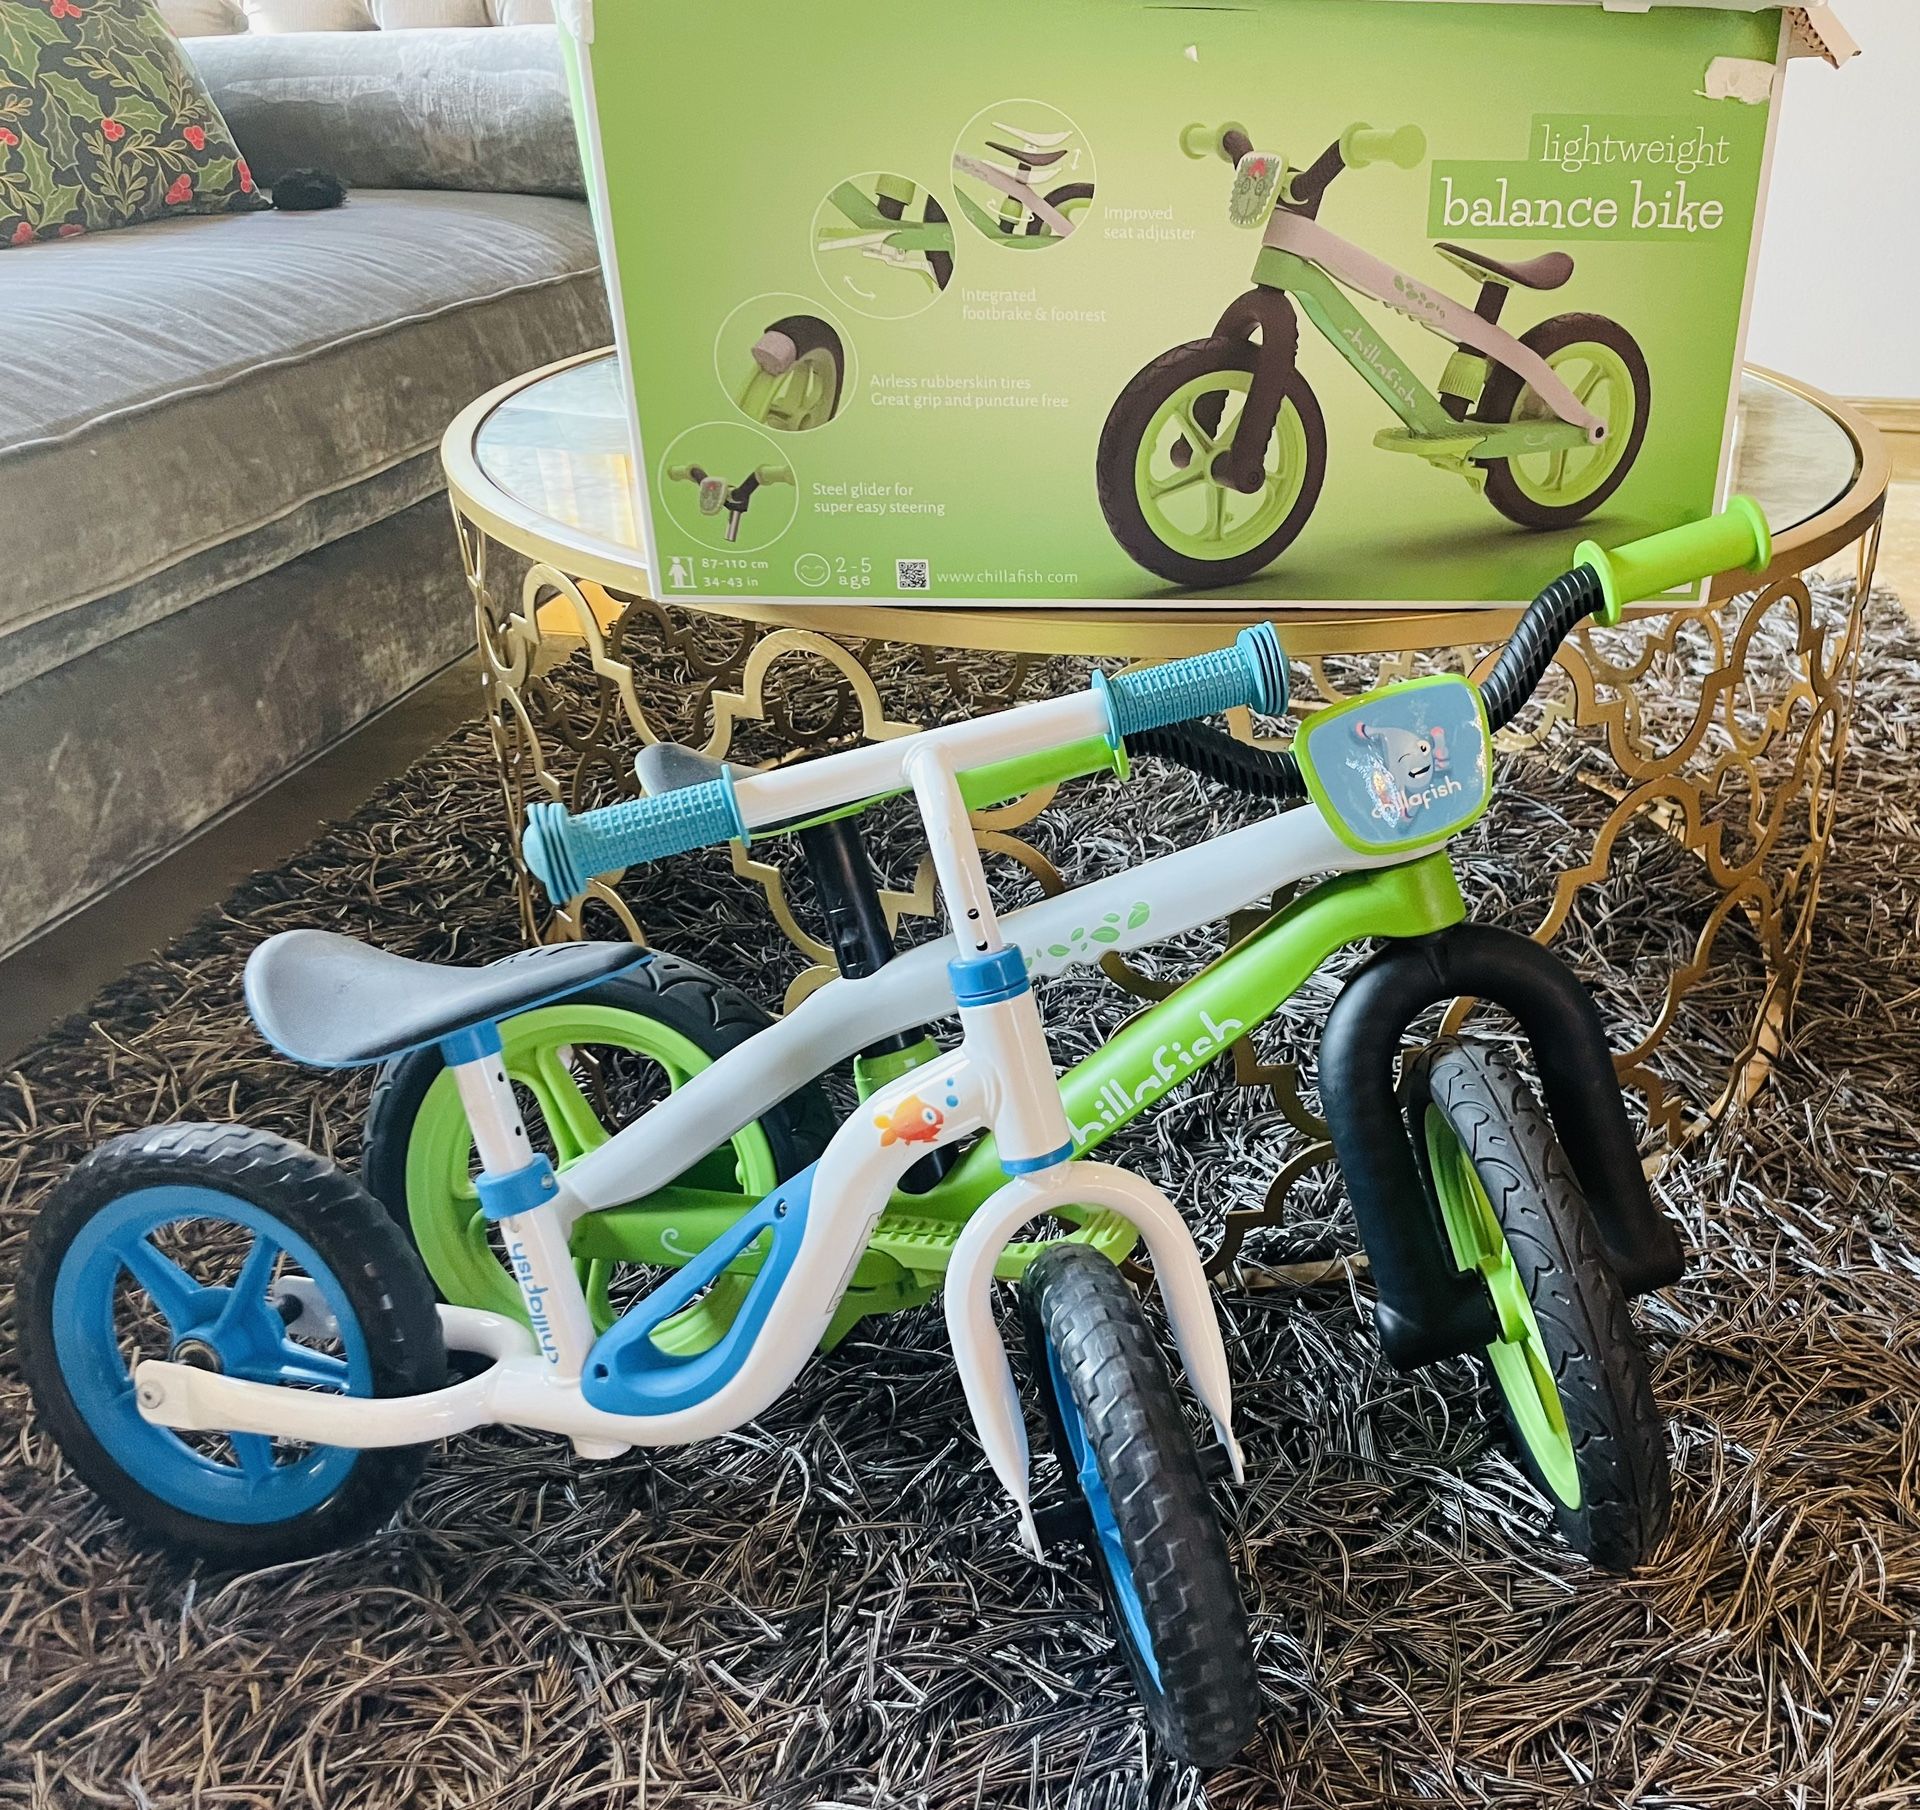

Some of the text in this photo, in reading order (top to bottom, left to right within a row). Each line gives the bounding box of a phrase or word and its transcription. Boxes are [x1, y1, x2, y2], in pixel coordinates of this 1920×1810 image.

[1539, 124, 1730, 174] lightweight
[1441, 177, 1724, 233] balance bike
[1104, 205, 1173, 223] Improved
[1103, 227, 1196, 243] seat adjuster
[961, 288, 1037, 305] Integrated
[962, 305, 1107, 322] footbrake & footrest
[870, 374, 1032, 390] Airless rubberskin tires
[871, 392, 1070, 409] Great grip and puncture free
[812, 483, 914, 499] Steel glider for
[814, 502, 946, 517] super easy steering
[701, 558, 769, 569] 87-110 cm
[703, 576, 759, 588] 34-43 in
[838, 575, 871, 590] age
[937, 570, 1079, 584] www.chillafish.com
[1066, 1010, 1244, 1146] hillafish
[511, 1242, 560, 1365] chillafish
